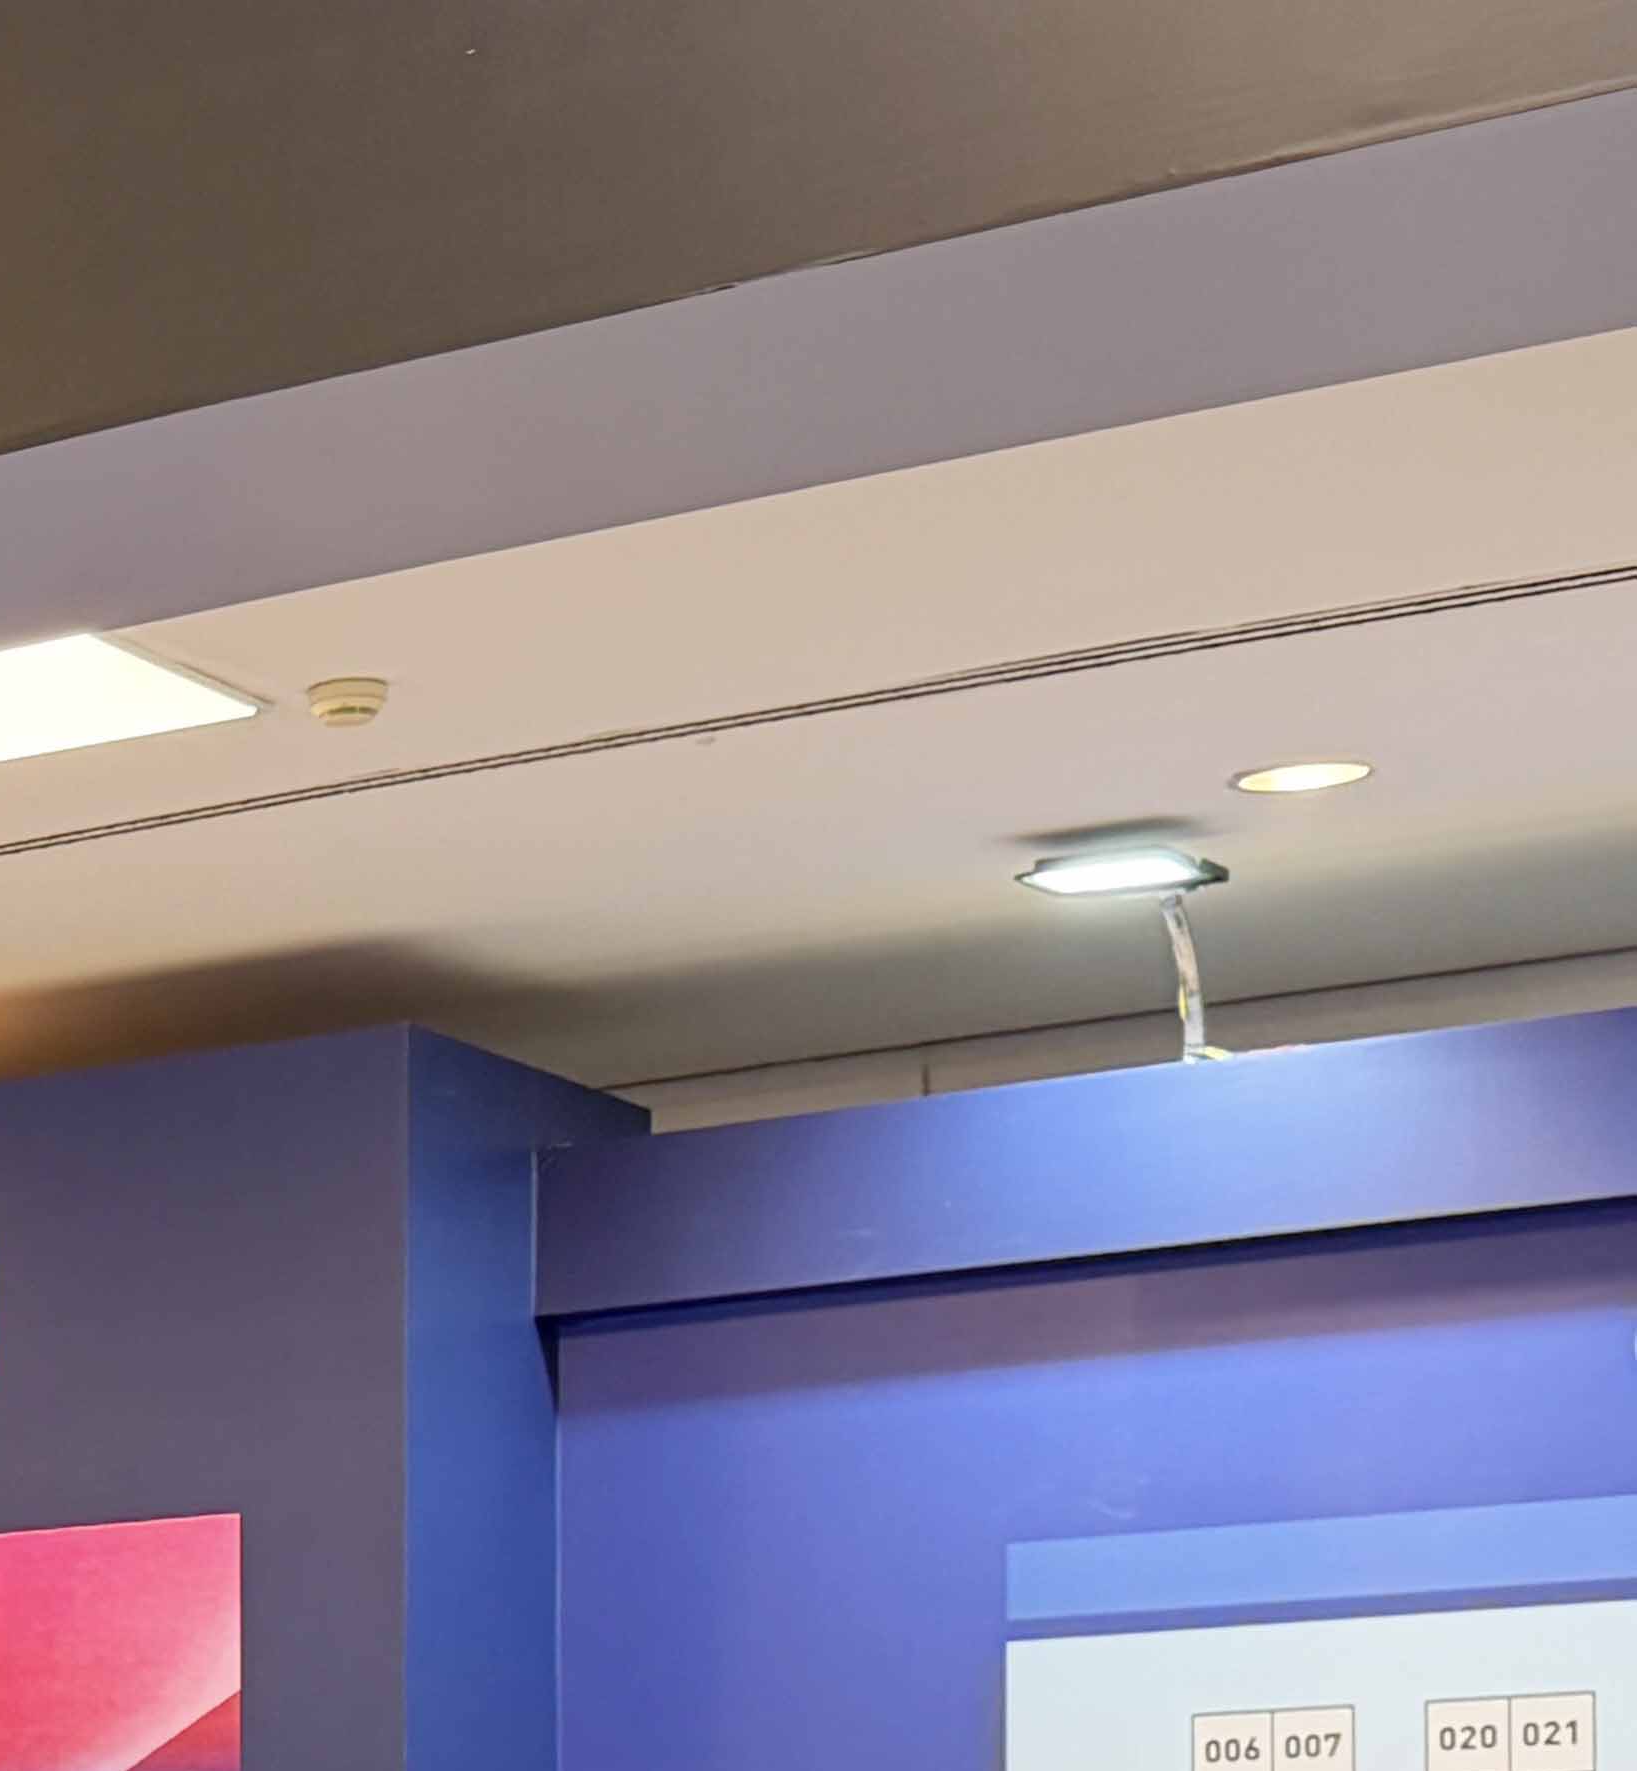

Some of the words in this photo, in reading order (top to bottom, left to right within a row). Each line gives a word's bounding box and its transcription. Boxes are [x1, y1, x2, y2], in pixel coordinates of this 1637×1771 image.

[1205, 1737, 1260, 1763] 006
[1285, 1732, 1342, 1759] 007
[1439, 1724, 1498, 1751] 020
[1522, 1720, 1578, 1747] 021
